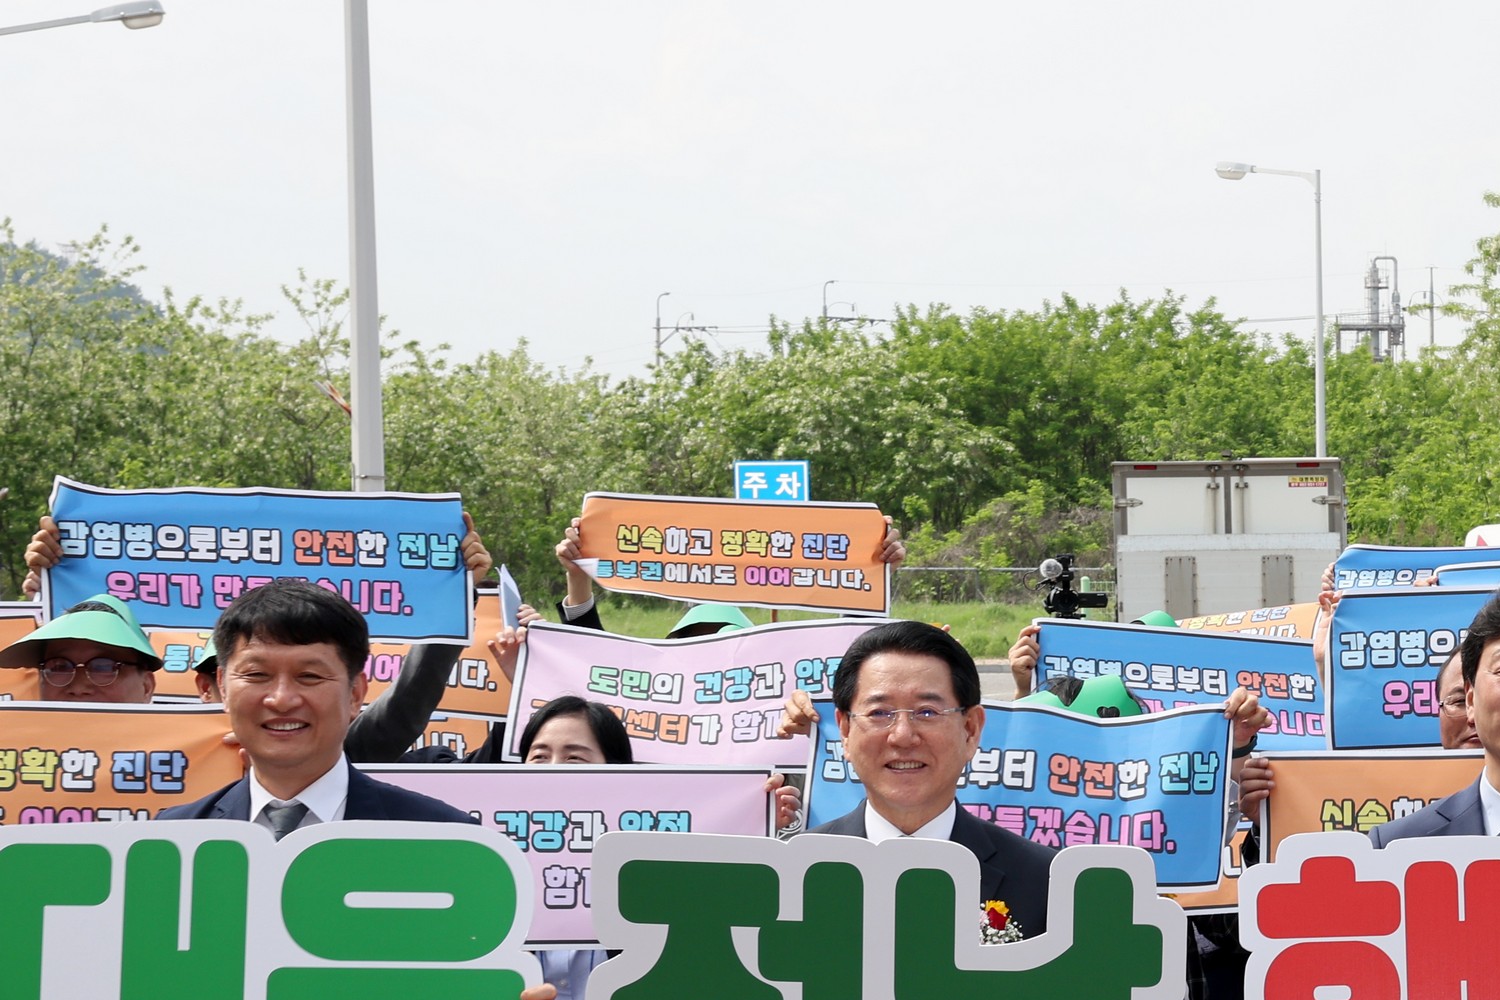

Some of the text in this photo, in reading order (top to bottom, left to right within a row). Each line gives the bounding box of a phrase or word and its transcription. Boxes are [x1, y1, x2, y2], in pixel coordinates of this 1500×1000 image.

[56, 519, 461, 570] 감염병으로부터 안전한 전남
[616, 524, 850, 560] 신속하고 정확한 진단
[744, 565, 872, 592] 이어갑니다.
[587, 665, 685, 704] 도민의
[694, 661, 785, 703] 건강과
[111, 750, 189, 793] 진단
[1048, 751, 1151, 802] 안전한
[1158, 751, 1221, 796] 전남
